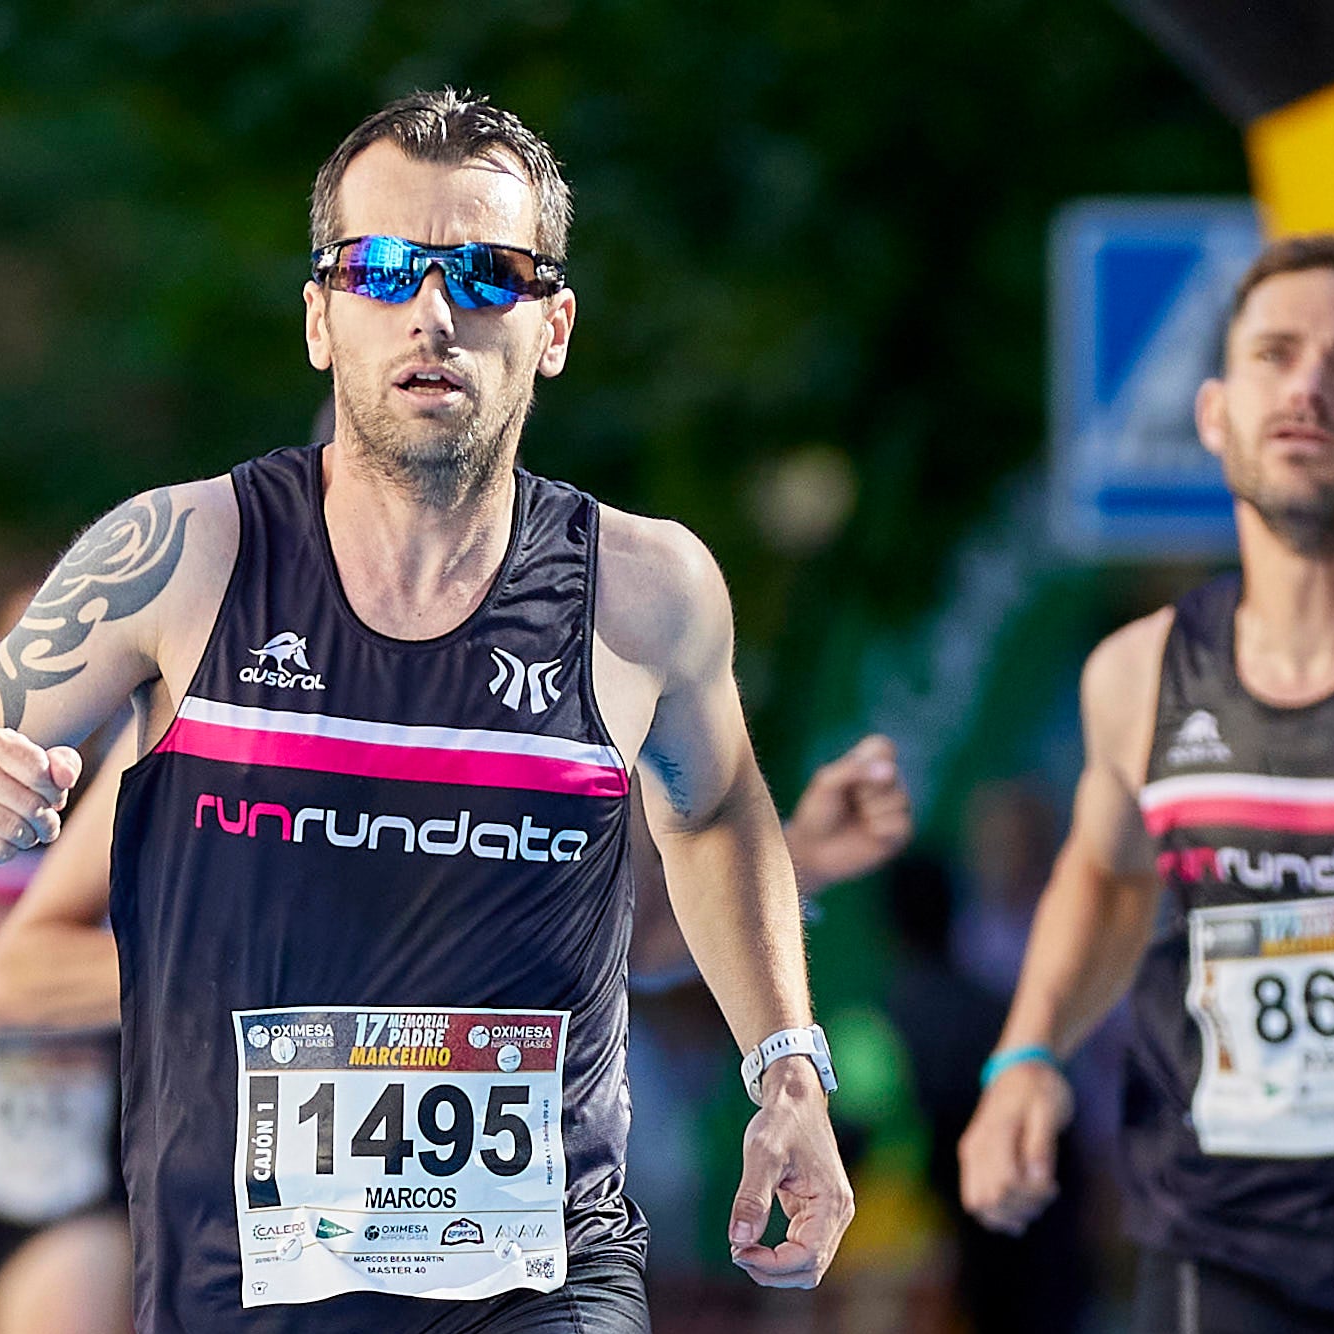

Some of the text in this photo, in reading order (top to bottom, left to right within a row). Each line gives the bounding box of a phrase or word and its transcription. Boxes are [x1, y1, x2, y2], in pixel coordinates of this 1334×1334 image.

[239, 666, 326, 691] austral
[194, 793, 589, 862] runrundata
[270, 1023, 334, 1037] OXIMESA
[354, 1013, 389, 1047] 17
[387, 1014, 450, 1029] MEMORIAL
[387, 1028, 446, 1048] PADRE
[491, 1025, 553, 1038] OXIMESA
[348, 1046, 452, 1067] MARCELINO
[298, 1082, 534, 1177] 1495
[253, 1102, 275, 1182] CAJÓN 1
[365, 1187, 457, 1209] MARCOS
[257, 1221, 305, 1237] CALERO
[381, 1224, 429, 1234] OXIMESA
[495, 1224, 549, 1238] ANAYA
[353, 1255, 388, 1263] MARCOS
[367, 1266, 427, 1274] MASTER 40
